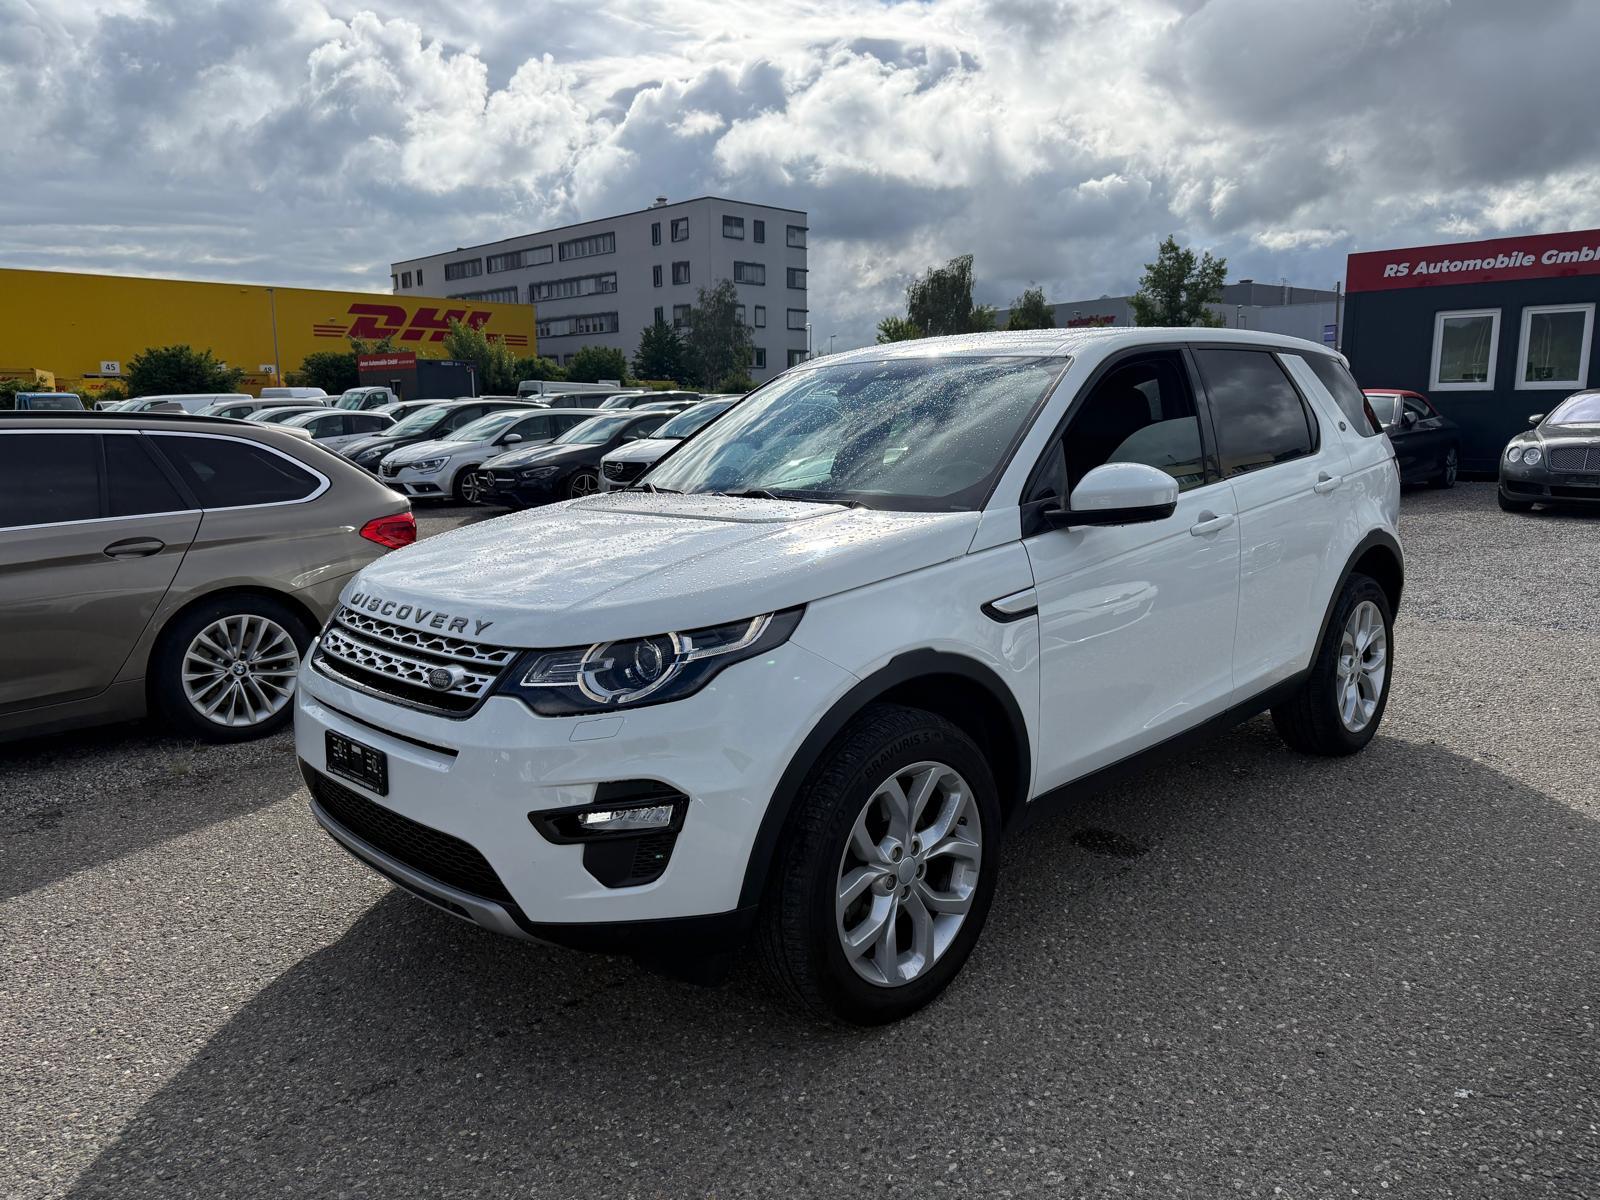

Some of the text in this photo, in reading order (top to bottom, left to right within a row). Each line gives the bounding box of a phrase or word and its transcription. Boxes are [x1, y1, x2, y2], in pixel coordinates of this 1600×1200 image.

[1383, 262, 1410, 278] RS
[1412, 251, 1536, 276] Automobile
[105, 363, 116, 371] 45
[350, 592, 495, 636] DISCOVERY
[863, 734, 922, 778] BRAVURIS
